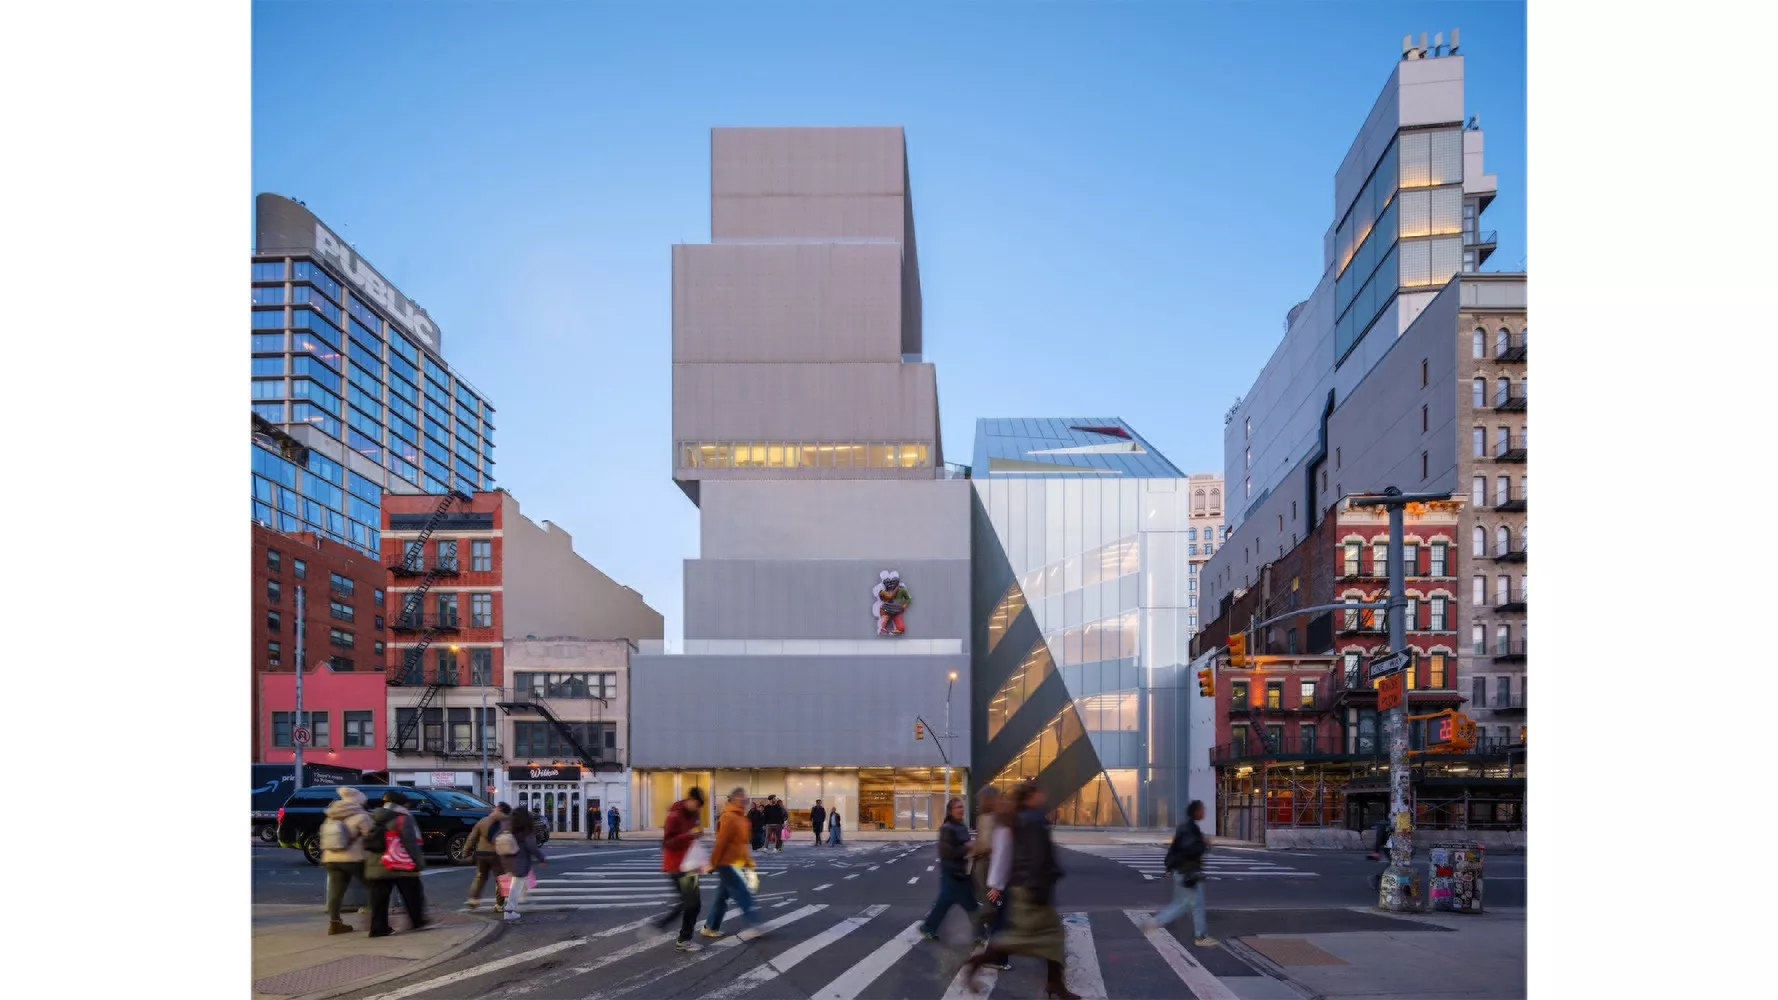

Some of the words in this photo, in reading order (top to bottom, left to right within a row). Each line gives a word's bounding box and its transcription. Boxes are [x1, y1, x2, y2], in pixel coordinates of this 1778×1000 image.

[315, 222, 433, 345] PUBLIC
[1373, 662, 1384, 673] ONE
[1389, 656, 1403, 667] WAY
[281, 774, 296, 783] pri
